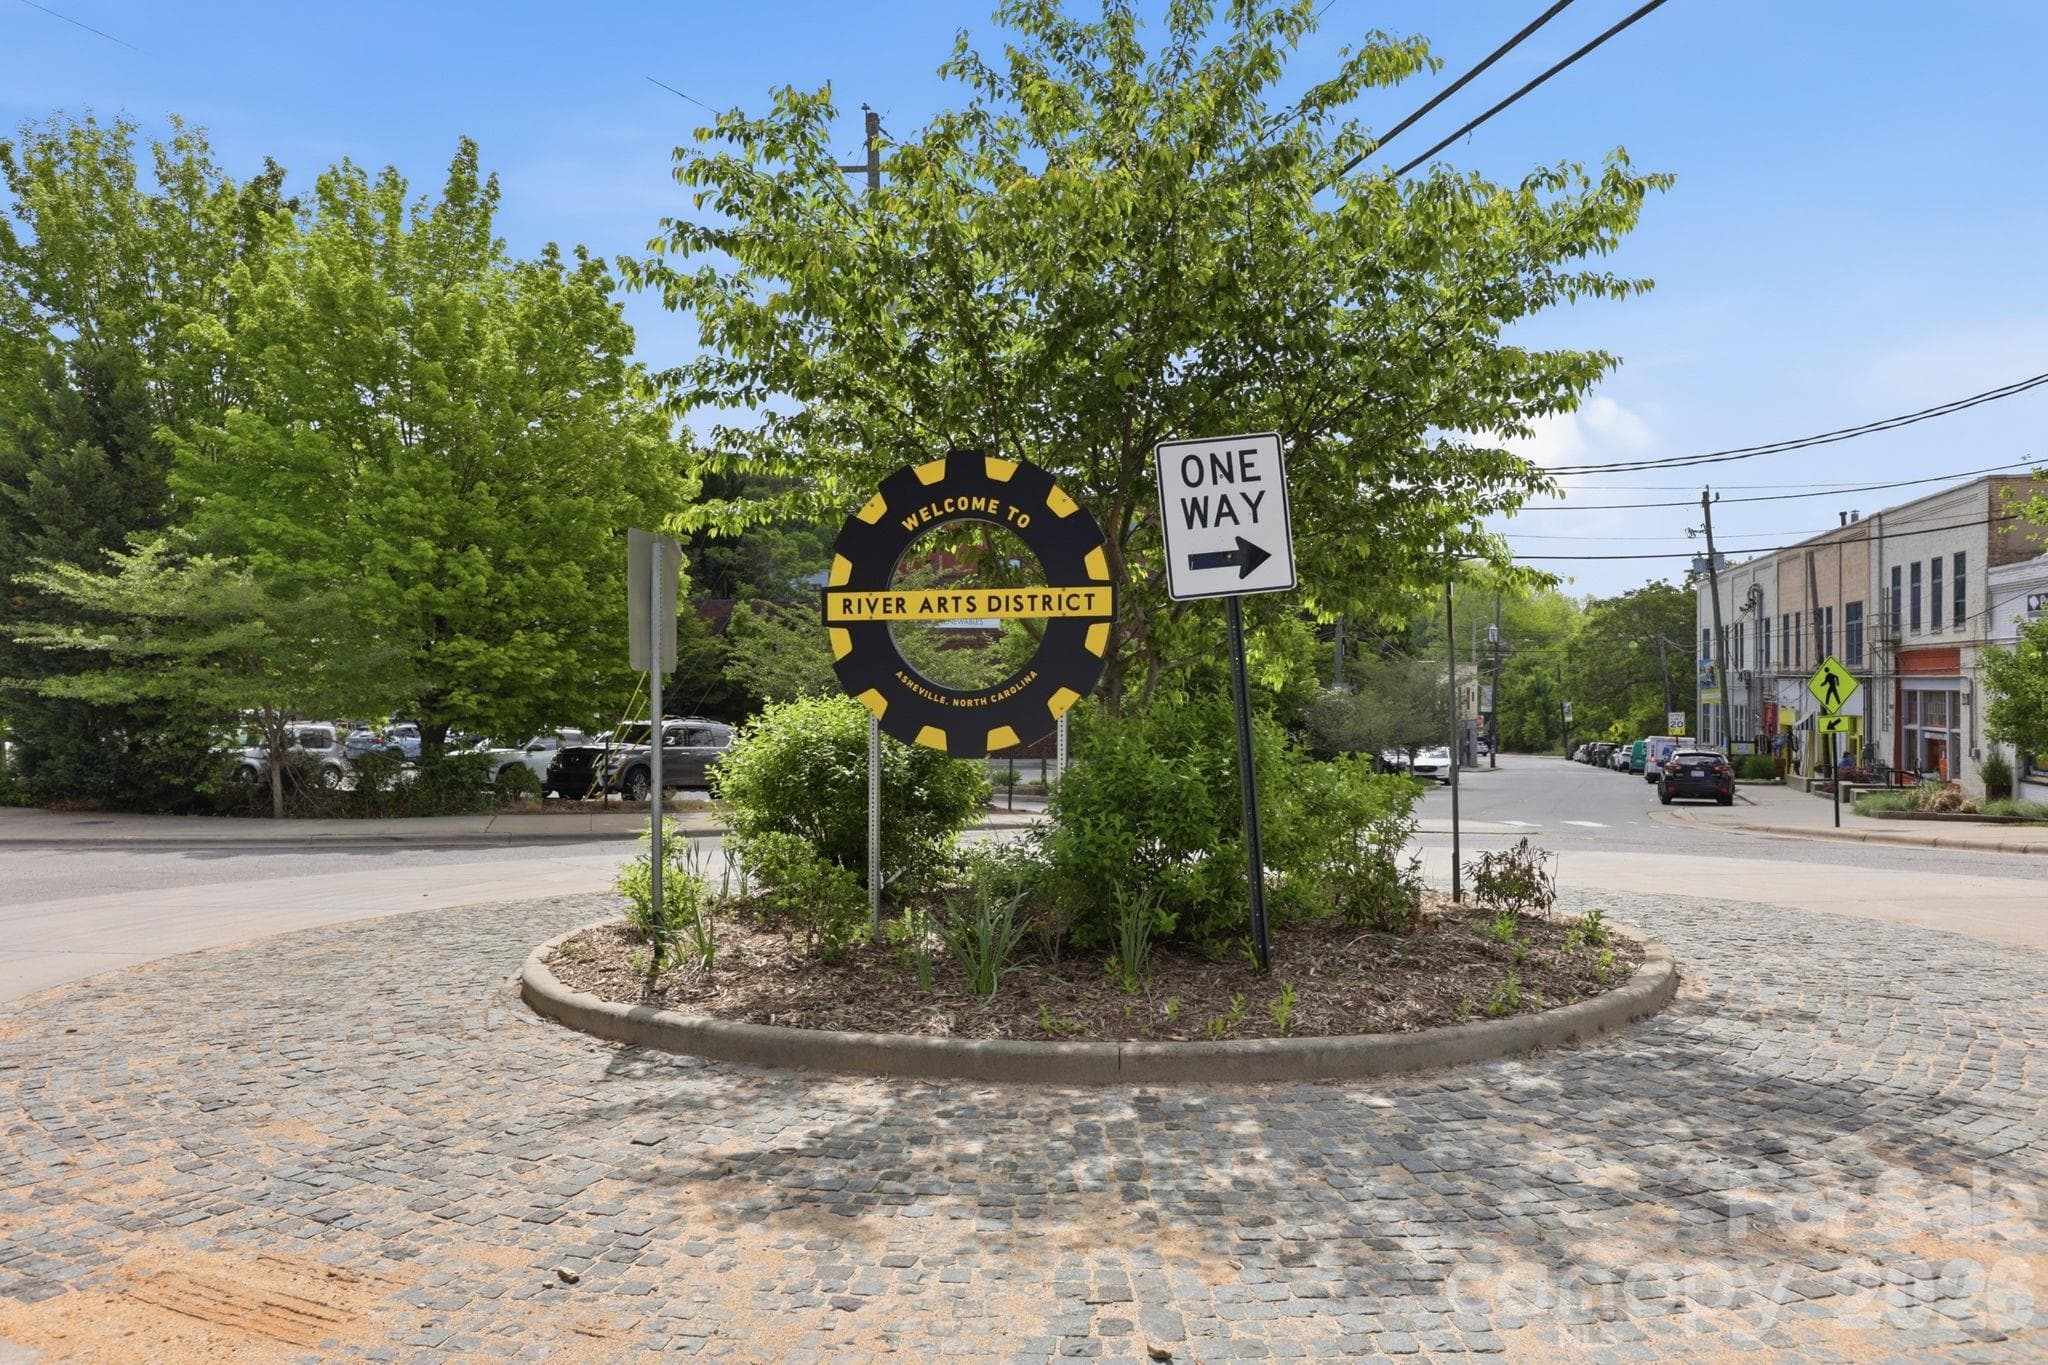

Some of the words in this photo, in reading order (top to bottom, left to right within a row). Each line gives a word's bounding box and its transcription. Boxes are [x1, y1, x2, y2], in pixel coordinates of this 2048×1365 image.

[1181, 449, 1261, 488] ONE
[901, 496, 1000, 532] WELCOME
[1007, 505, 1031, 529] TO
[1180, 490, 1266, 530] WAY
[842, 597, 907, 615] RIVER
[918, 595, 977, 614] ARTS
[987, 593, 1096, 613] DISTRICT
[895, 671, 949, 706] ASHEVILLE,
[952, 697, 988, 708] NORTH
[990, 670, 1038, 703] CAROLINA
[1670, 720, 1684, 728] 20
